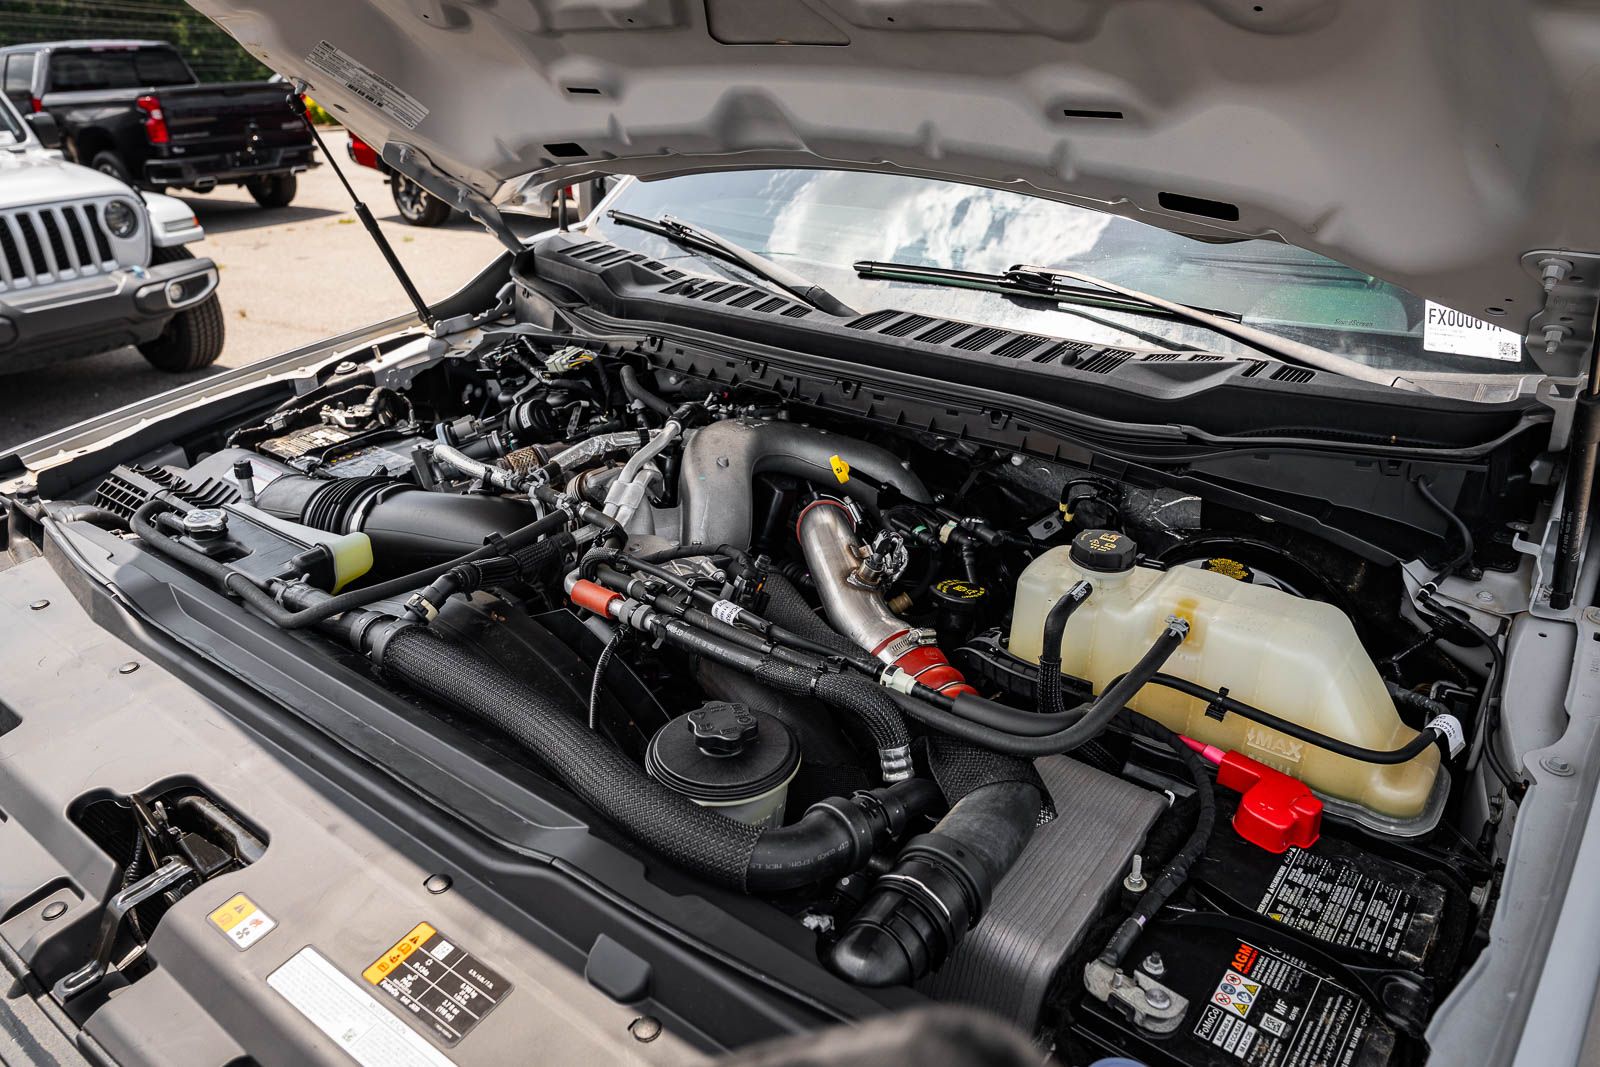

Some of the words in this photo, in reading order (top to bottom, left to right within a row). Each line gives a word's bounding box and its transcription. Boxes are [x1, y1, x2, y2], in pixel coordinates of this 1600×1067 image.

[1255, 730, 1303, 759] MAX
[1232, 944, 1252, 971] AGM
[1274, 999, 1287, 1015] MF
[1198, 1007, 1220, 1038] FoMoCo
